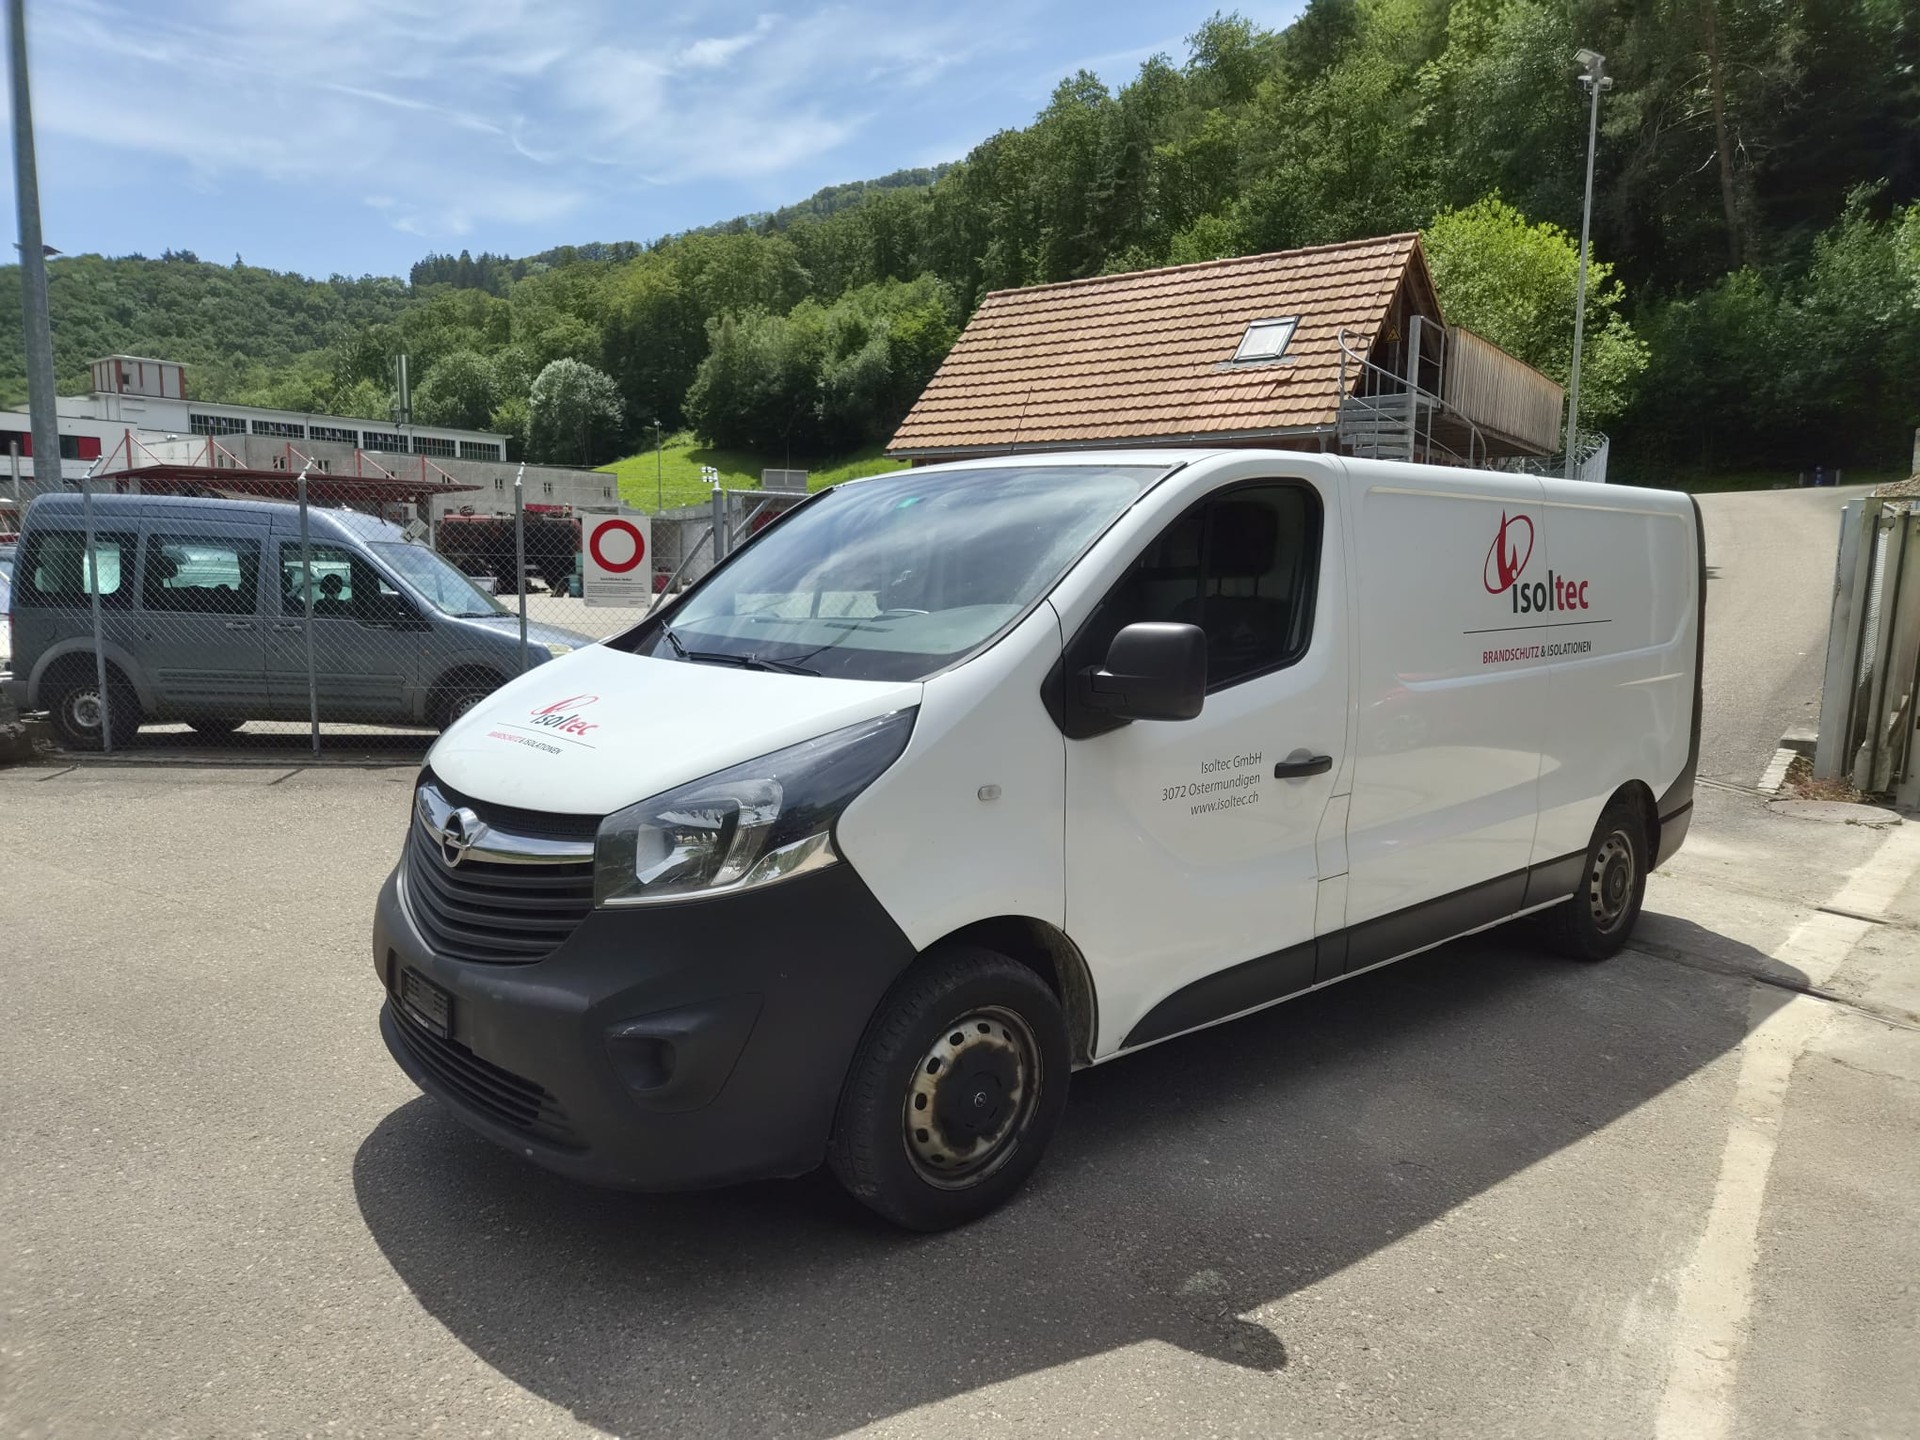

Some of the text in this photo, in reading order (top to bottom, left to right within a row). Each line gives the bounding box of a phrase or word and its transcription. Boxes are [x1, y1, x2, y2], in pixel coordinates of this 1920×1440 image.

[1512, 569, 1589, 613] isoltec
[1482, 641, 1592, 664] BRANDSCHUTZ & ISOLATIONEN
[530, 713, 599, 735] isoltec
[1201, 752, 1262, 774] Isoltec GmbH
[1162, 774, 1260, 801] 3072 Ostermundigen
[1190, 791, 1259, 815] www.isoltec.ch
